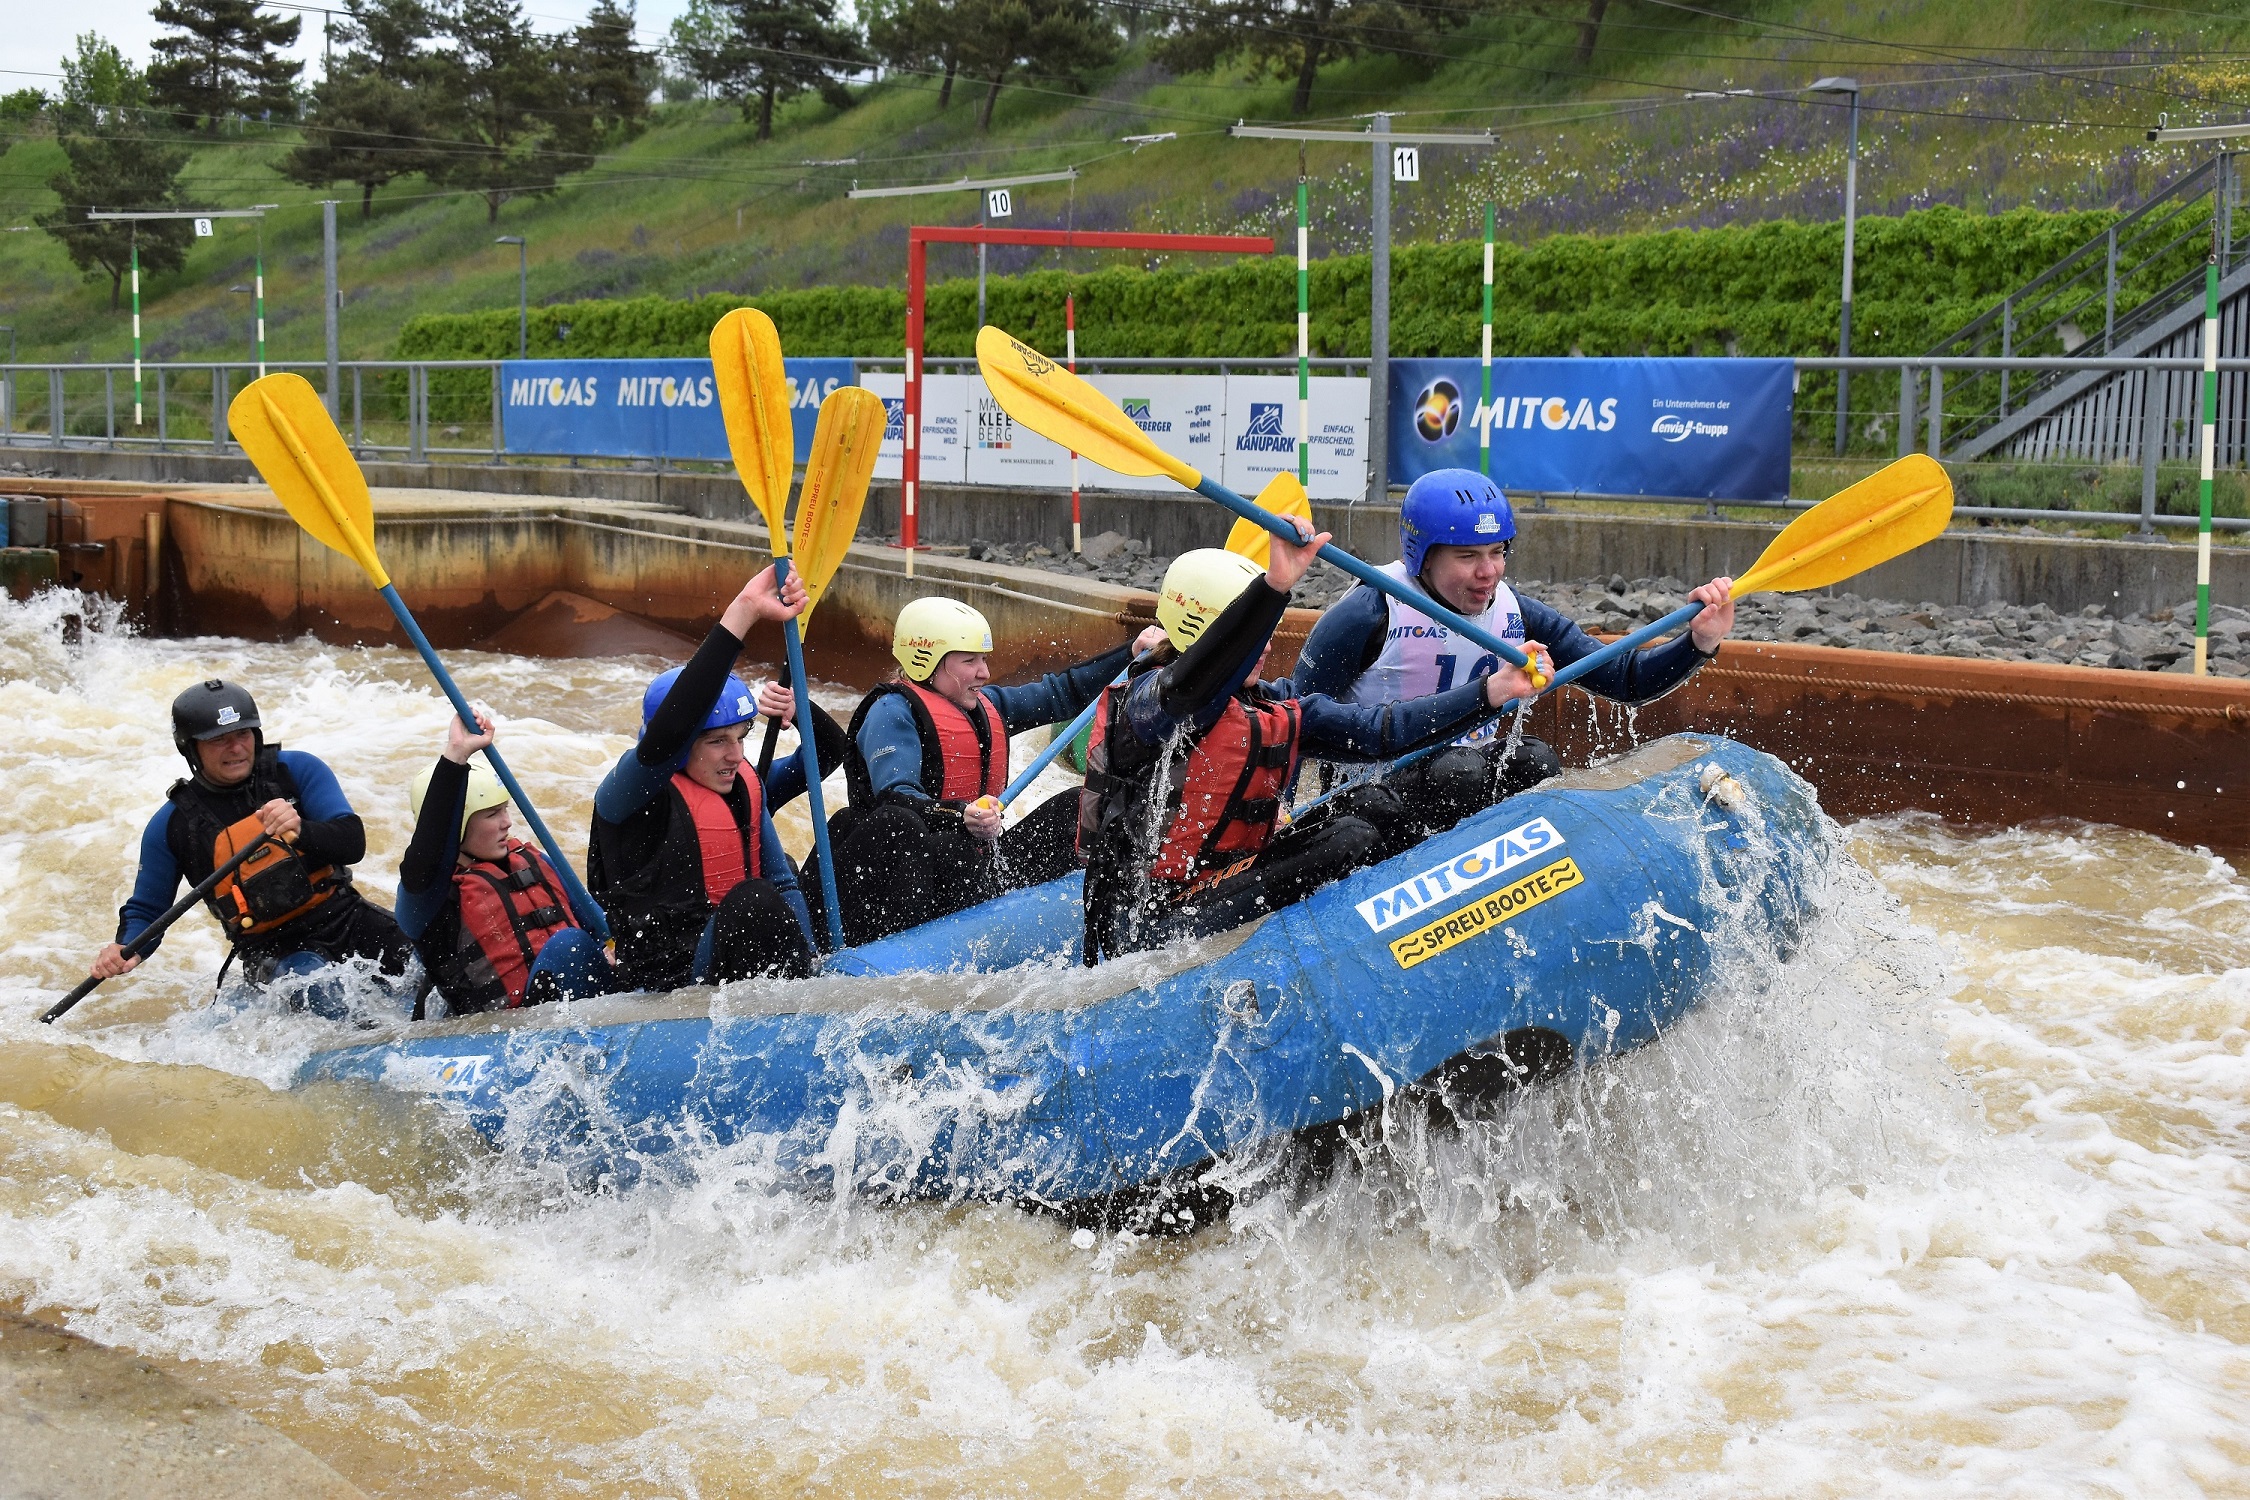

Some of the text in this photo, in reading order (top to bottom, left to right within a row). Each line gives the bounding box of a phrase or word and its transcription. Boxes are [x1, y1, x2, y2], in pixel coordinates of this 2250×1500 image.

[1398, 152, 1413, 176] 11
[992, 193, 1008, 213] 10
[201, 221, 207, 234] 8
[510, 377, 598, 407] MITGAS
[617, 376, 713, 408] MITGAS
[1194, 404, 1211, 416] ganz
[1653, 399, 1731, 409] Ein Unternehmen der
[936, 416, 958, 424] EINFACH.
[979, 412, 1012, 427] KLEE
[1470, 396, 1618, 432] MITGAS
[1189, 418, 1211, 429] meine
[1323, 425, 1355, 434] EINFACH.
[979, 427, 1012, 441] BERG
[1188, 432, 1211, 444] Welle!
[1236, 435, 1296, 452] KANUPARK
[1334, 448, 1355, 457] WILD!
[802, 483, 820, 538] SPREU BOOTE
[1373, 822, 1551, 926] MITGAS
[1423, 875, 1552, 949] SPREU BOOTE
